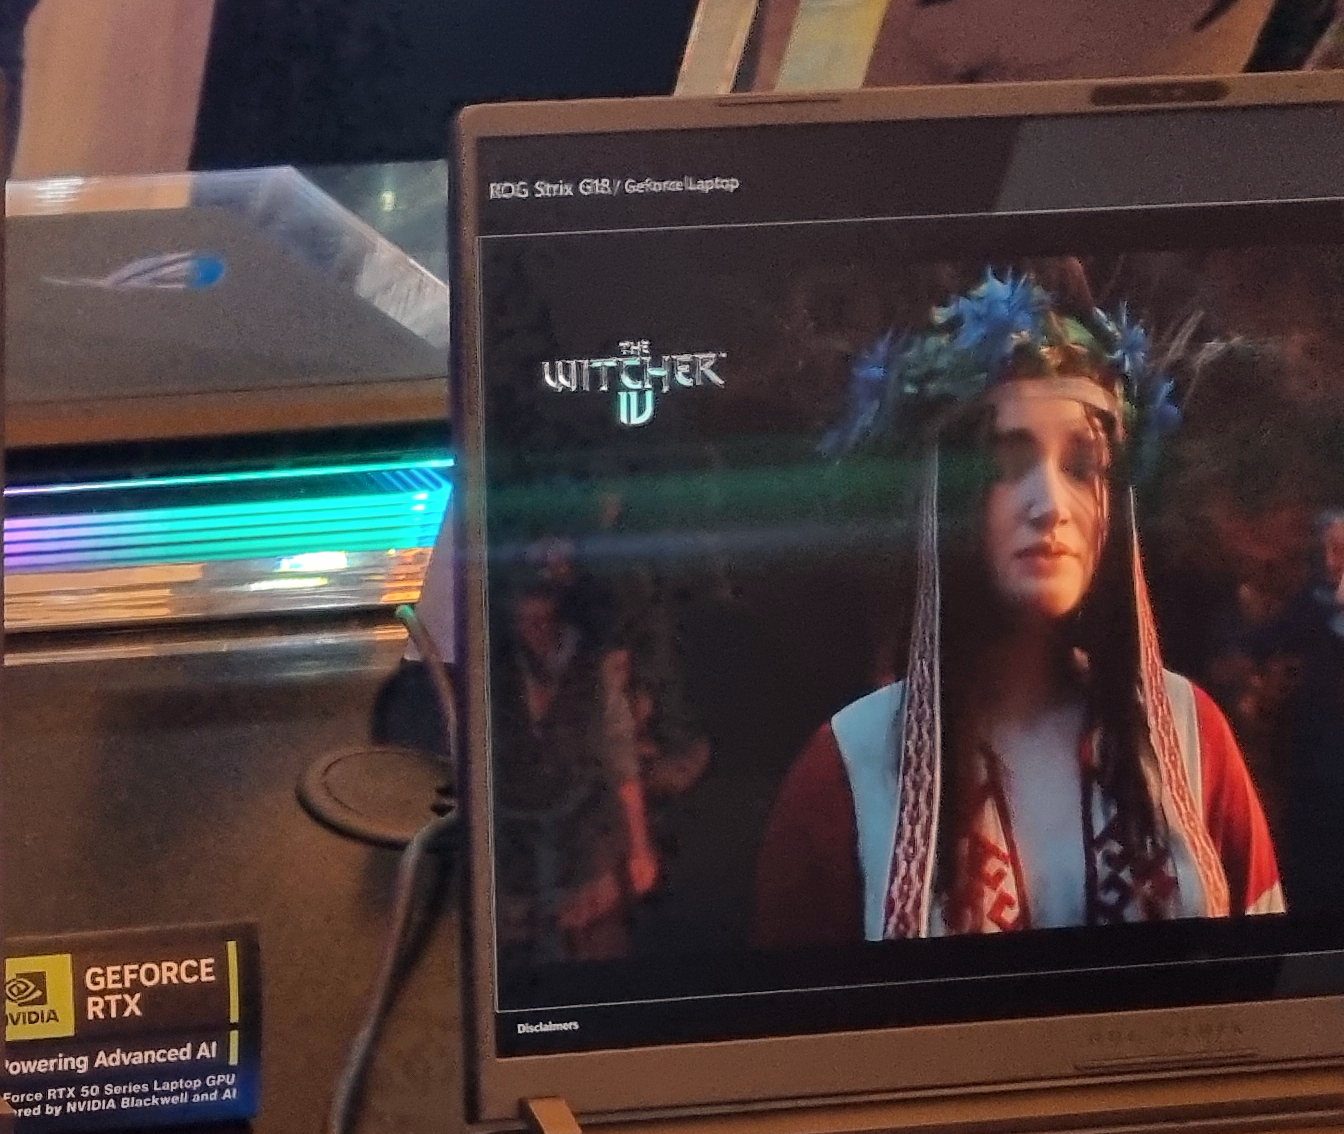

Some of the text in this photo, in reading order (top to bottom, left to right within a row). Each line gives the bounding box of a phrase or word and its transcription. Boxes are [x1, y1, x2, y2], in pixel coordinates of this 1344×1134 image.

[533, 180, 574, 198] Strix
[578, 178, 613, 197] G18
[684, 176, 741, 194] Laptop
[619, 339, 650, 355] THE
[541, 352, 728, 393] WITCHER
[86, 958, 215, 990] GEFORCE
[6, 1009, 59, 1026] VIDIA
[88, 993, 141, 1019] RTX
[518, 1021, 579, 1033] Disclaimers
[94, 1043, 191, 1067] Advanced
[197, 1042, 216, 1059] AI
[48, 1087, 75, 1099] RTX
[81, 1085, 99, 1097] 50
[105, 1083, 148, 1095] Series
[154, 1079, 201, 1091] Laptop
[206, 1074, 235, 1086] GPU
[45, 1104, 62, 1116] by
[67, 1099, 116, 1112] NVIDIA
[121, 1092, 188, 1108] Blackwell
[192, 1088, 217, 1102] and
[222, 1088, 236, 1100] AI
